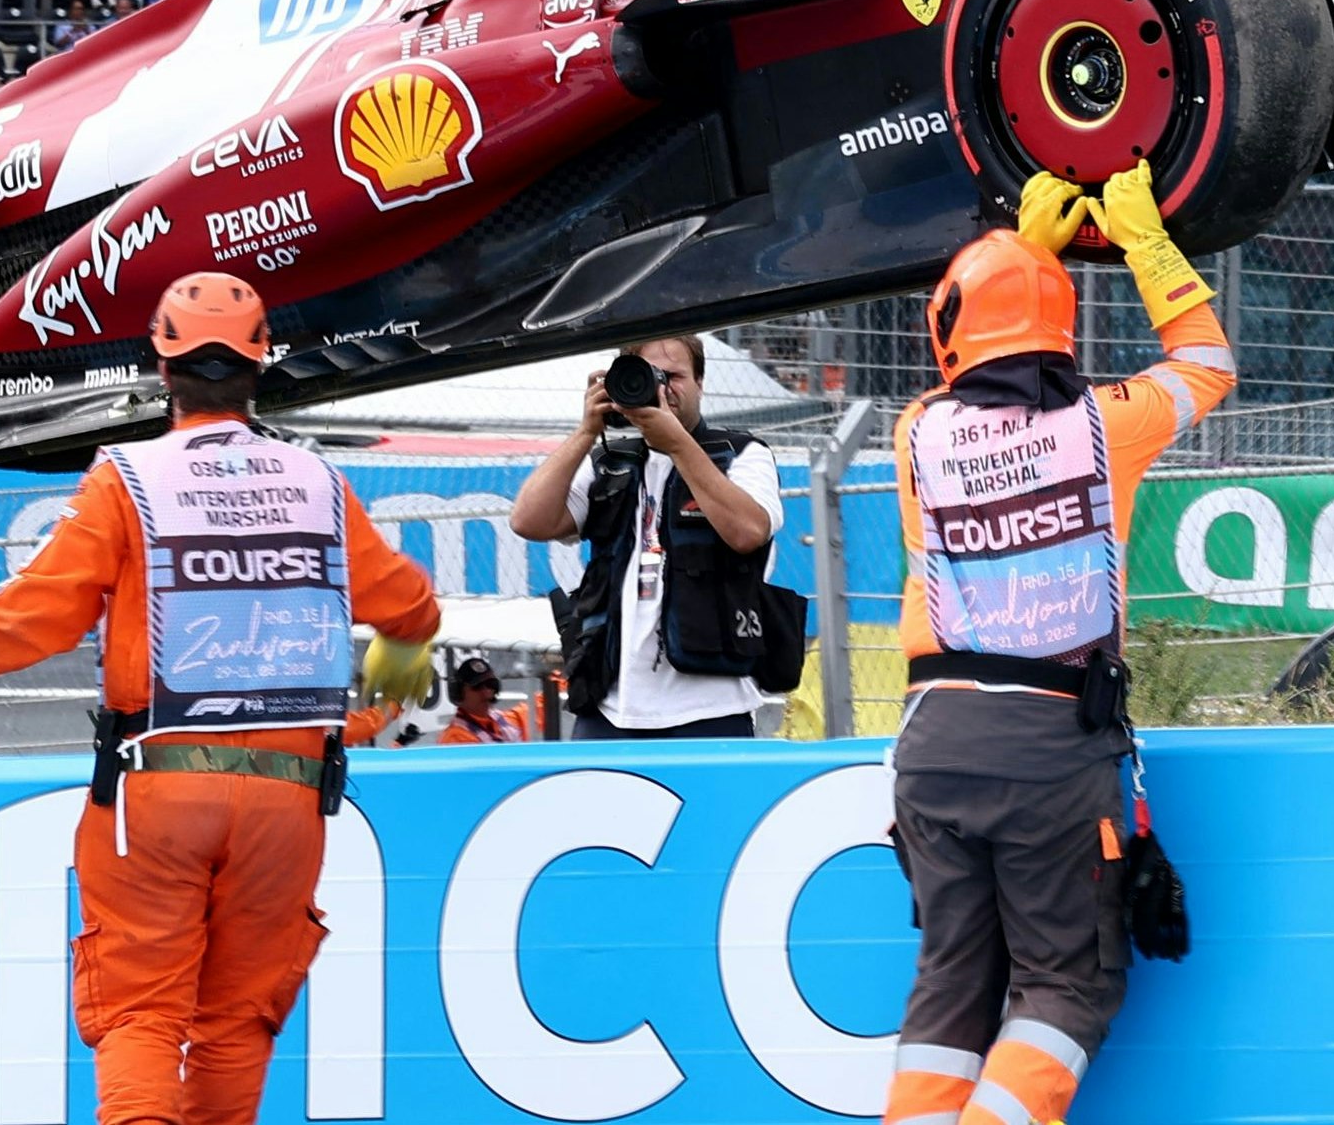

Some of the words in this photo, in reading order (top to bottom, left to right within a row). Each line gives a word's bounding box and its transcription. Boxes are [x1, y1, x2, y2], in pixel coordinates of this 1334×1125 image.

[838, 109, 950, 156] ambipa
[240, 145, 305, 177] LOGISTICS
[205, 189, 313, 248] PERONI
[214, 240, 260, 262] NASTRO
[261, 222, 318, 248] AZZURRO
[83, 364, 139, 388] MAHLE
[175, 486, 309, 508] INTERVENTION
[205, 507, 295, 527] MARSHAL
[944, 494, 1084, 554] COURSE
[182, 546, 323, 582] COURSE
